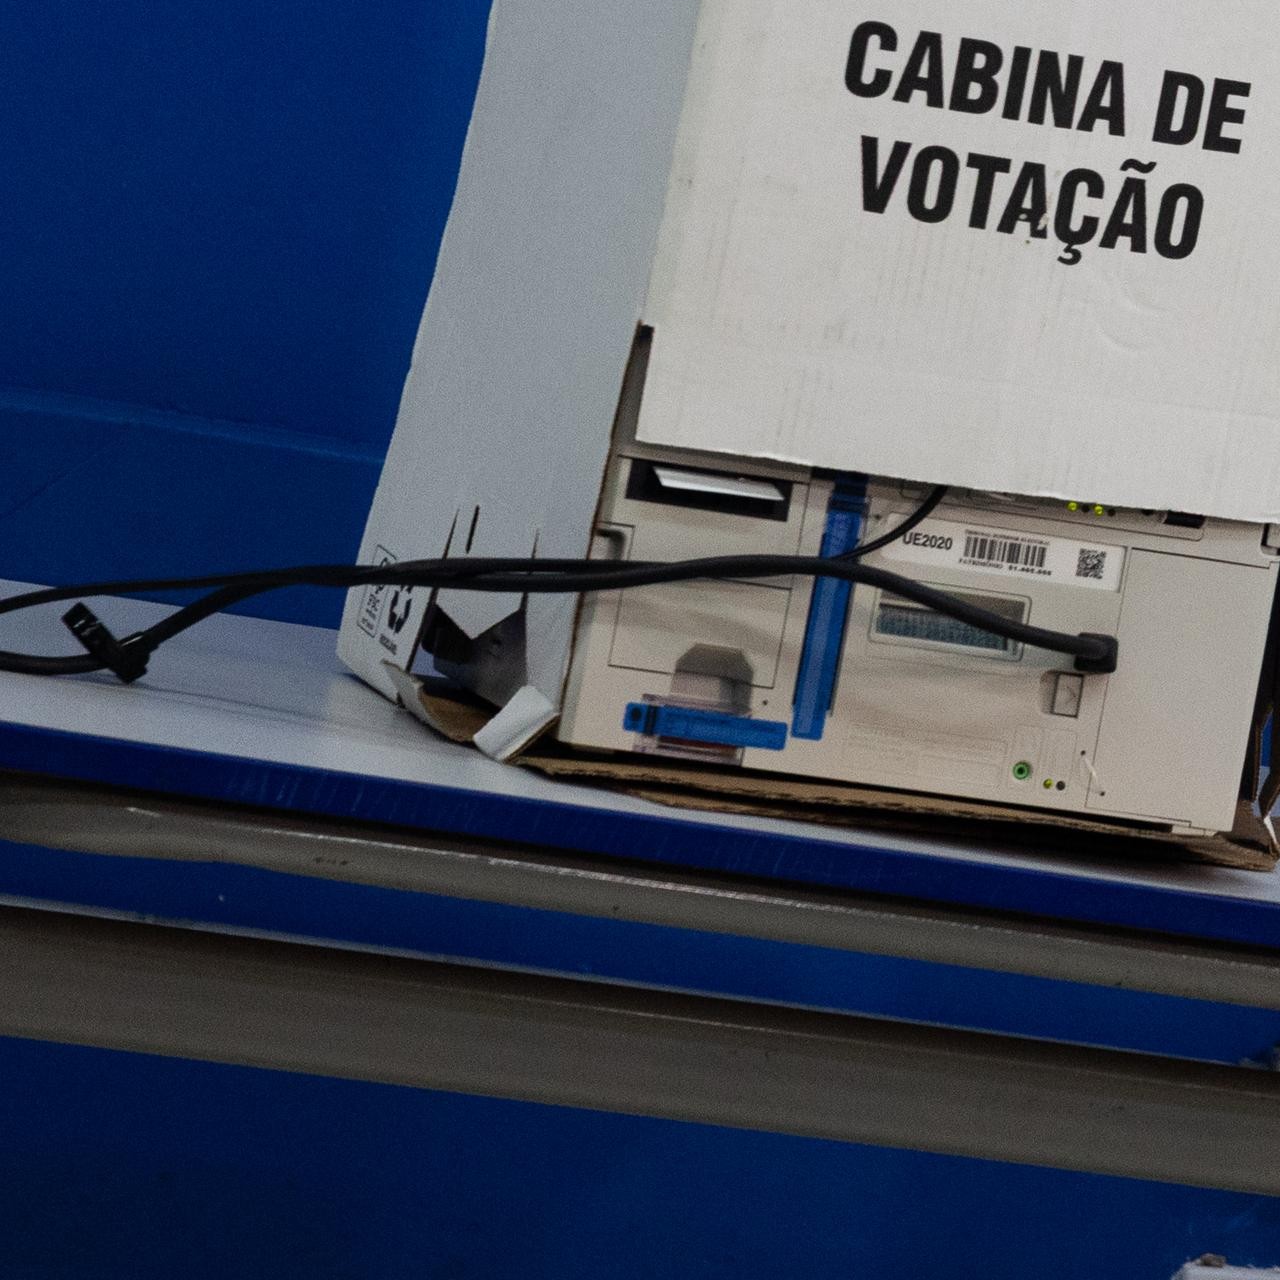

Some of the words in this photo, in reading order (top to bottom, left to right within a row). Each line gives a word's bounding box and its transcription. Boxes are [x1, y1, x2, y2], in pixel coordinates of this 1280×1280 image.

[844, 21, 1125, 137] CABINA
[1152, 70, 1252, 154] DE
[860, 135, 1204, 265] VOTAÇÃO
[902, 531, 953, 550] UE2020
